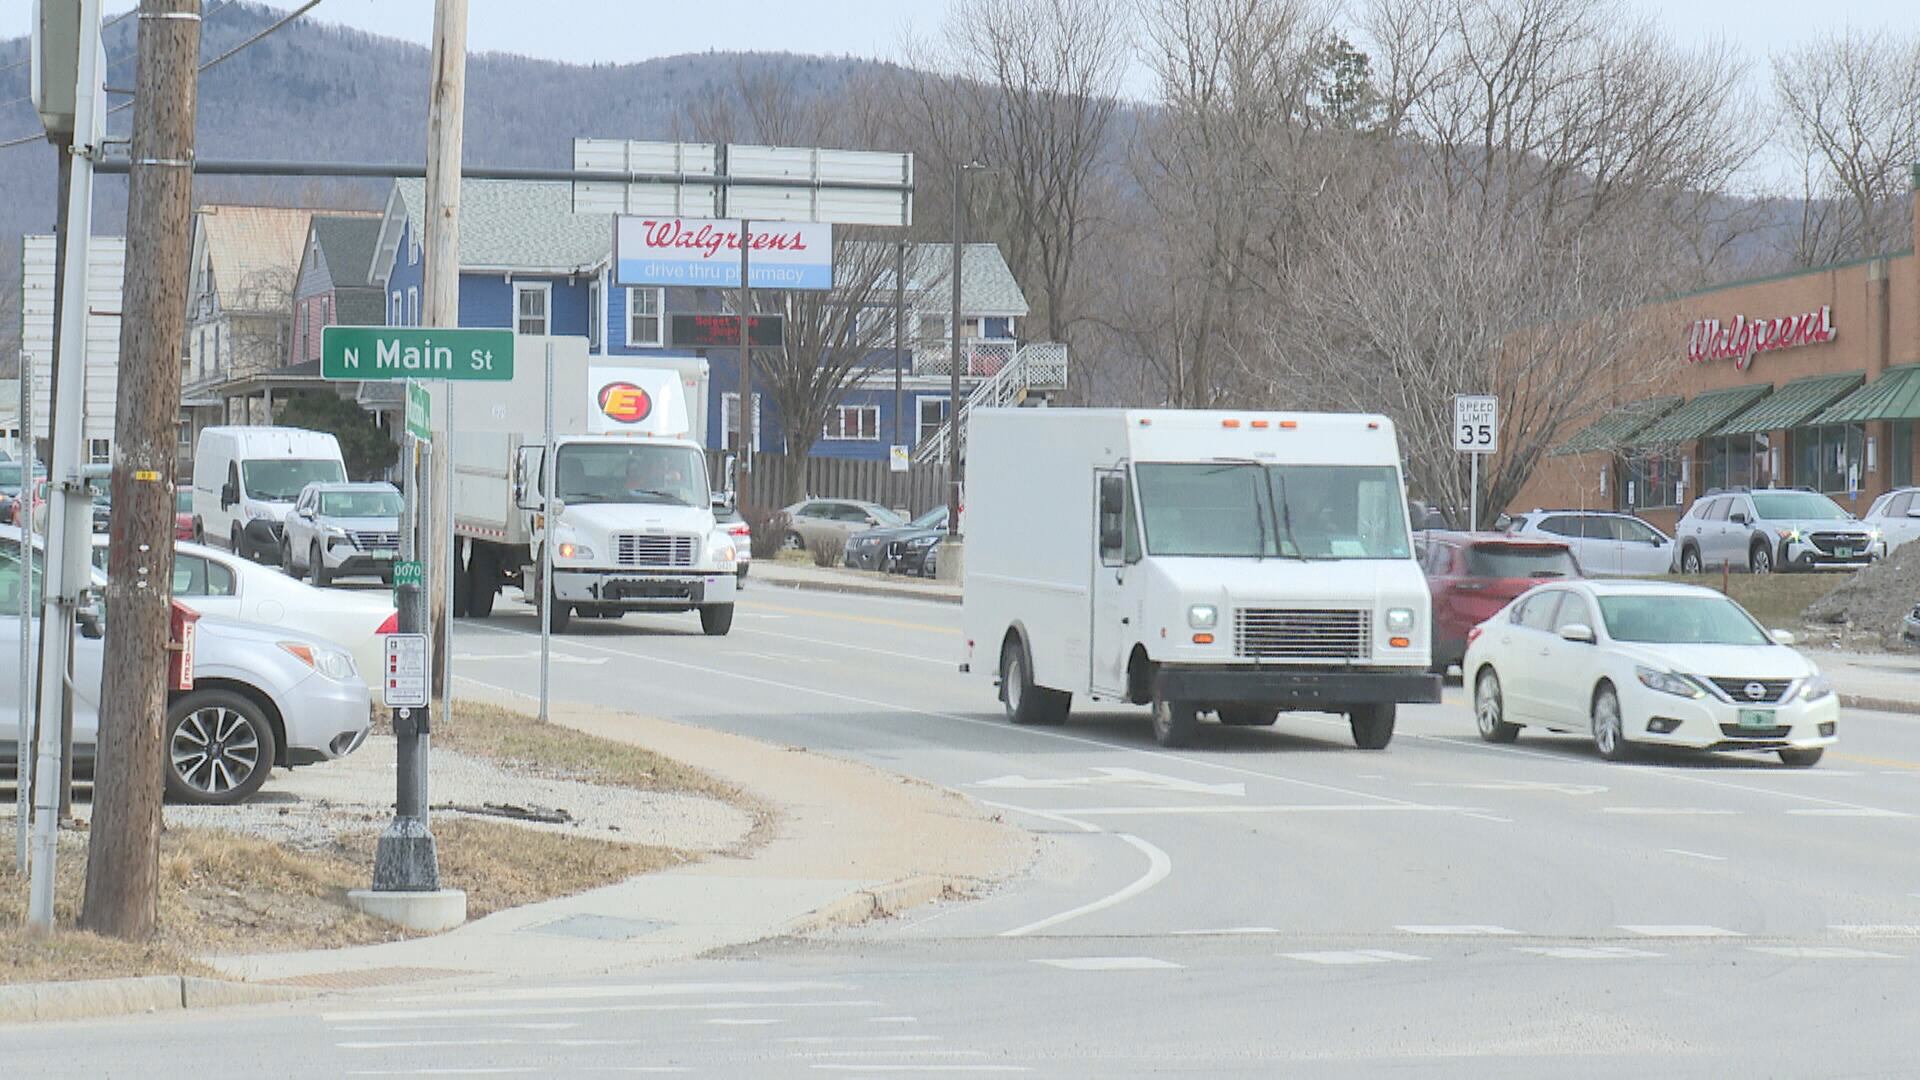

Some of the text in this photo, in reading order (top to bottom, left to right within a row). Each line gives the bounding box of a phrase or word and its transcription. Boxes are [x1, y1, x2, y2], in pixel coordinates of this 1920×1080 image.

[642, 218, 807, 259] Walgreens
[644, 263, 685, 278] drive
[688, 263, 720, 280] thru
[1687, 304, 1837, 372] Walgreens
[344, 339, 493, 370] N Main St
[603, 388, 642, 415] E
[1459, 402, 1494, 412] SPEED
[1462, 413, 1489, 423] LIMIT
[1460, 425, 1491, 444] 35
[395, 565, 421, 577] 0070
[184, 624, 193, 681] FIRE
